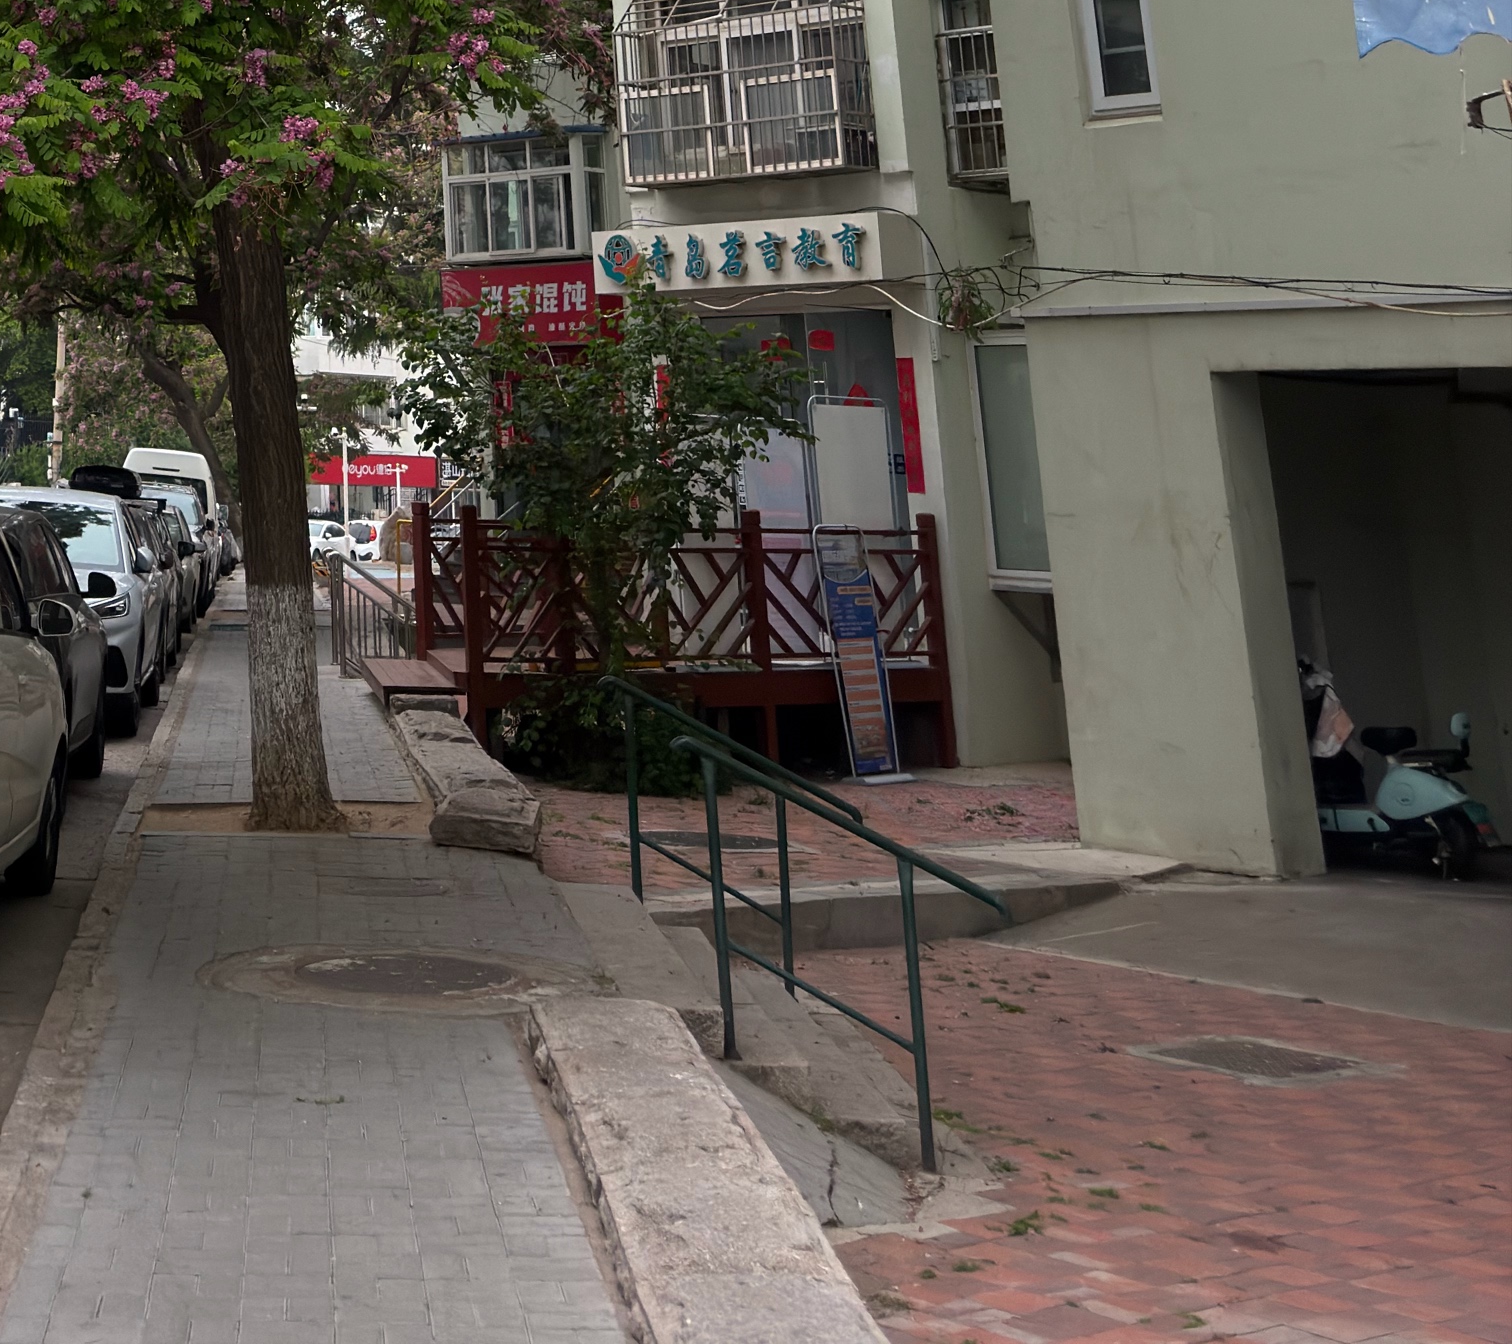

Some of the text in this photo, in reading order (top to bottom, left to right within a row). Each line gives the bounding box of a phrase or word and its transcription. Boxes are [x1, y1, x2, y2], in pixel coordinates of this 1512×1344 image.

[647, 222, 867, 280] 青岛茗言教育
